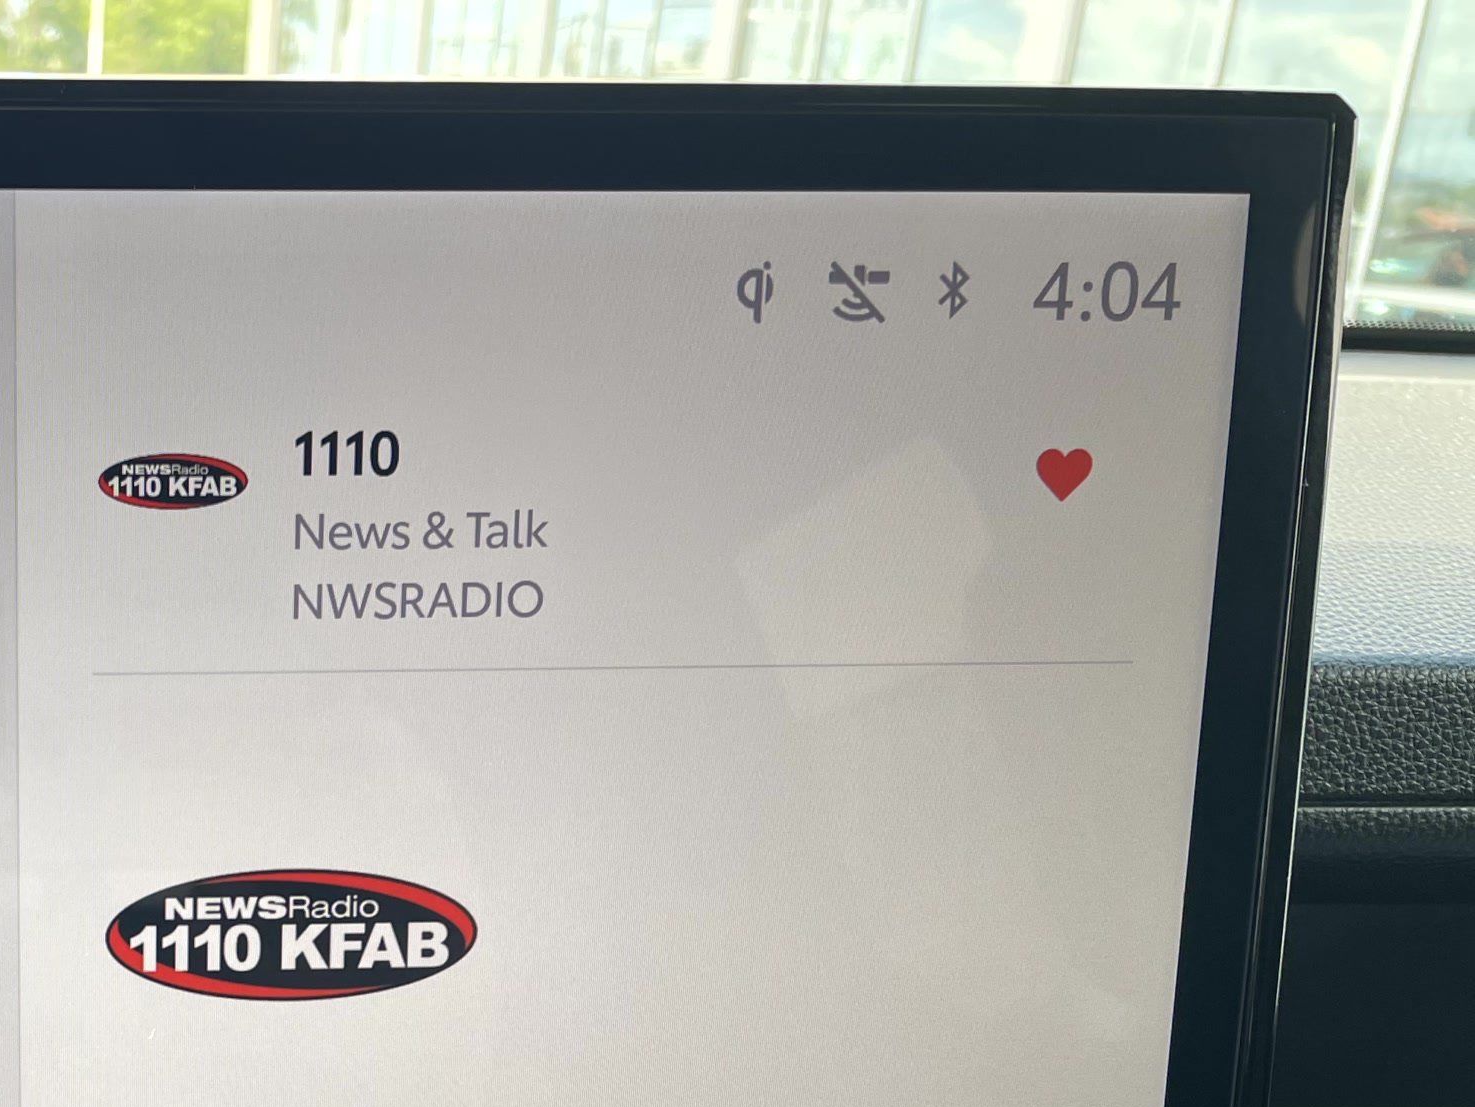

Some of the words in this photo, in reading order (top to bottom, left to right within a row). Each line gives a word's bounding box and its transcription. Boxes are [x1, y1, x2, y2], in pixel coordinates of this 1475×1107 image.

[1032, 261, 1182, 322] 4:04
[295, 430, 400, 477] 1110
[108, 476, 161, 497] 1110
[169, 475, 237, 497] KFAB
[294, 513, 410, 550] News
[422, 511, 454, 550] &
[466, 509, 549, 549] Talk
[292, 580, 544, 619] NWSRADIO
[129, 924, 262, 972] 1110
[280, 921, 449, 970] KFAB
